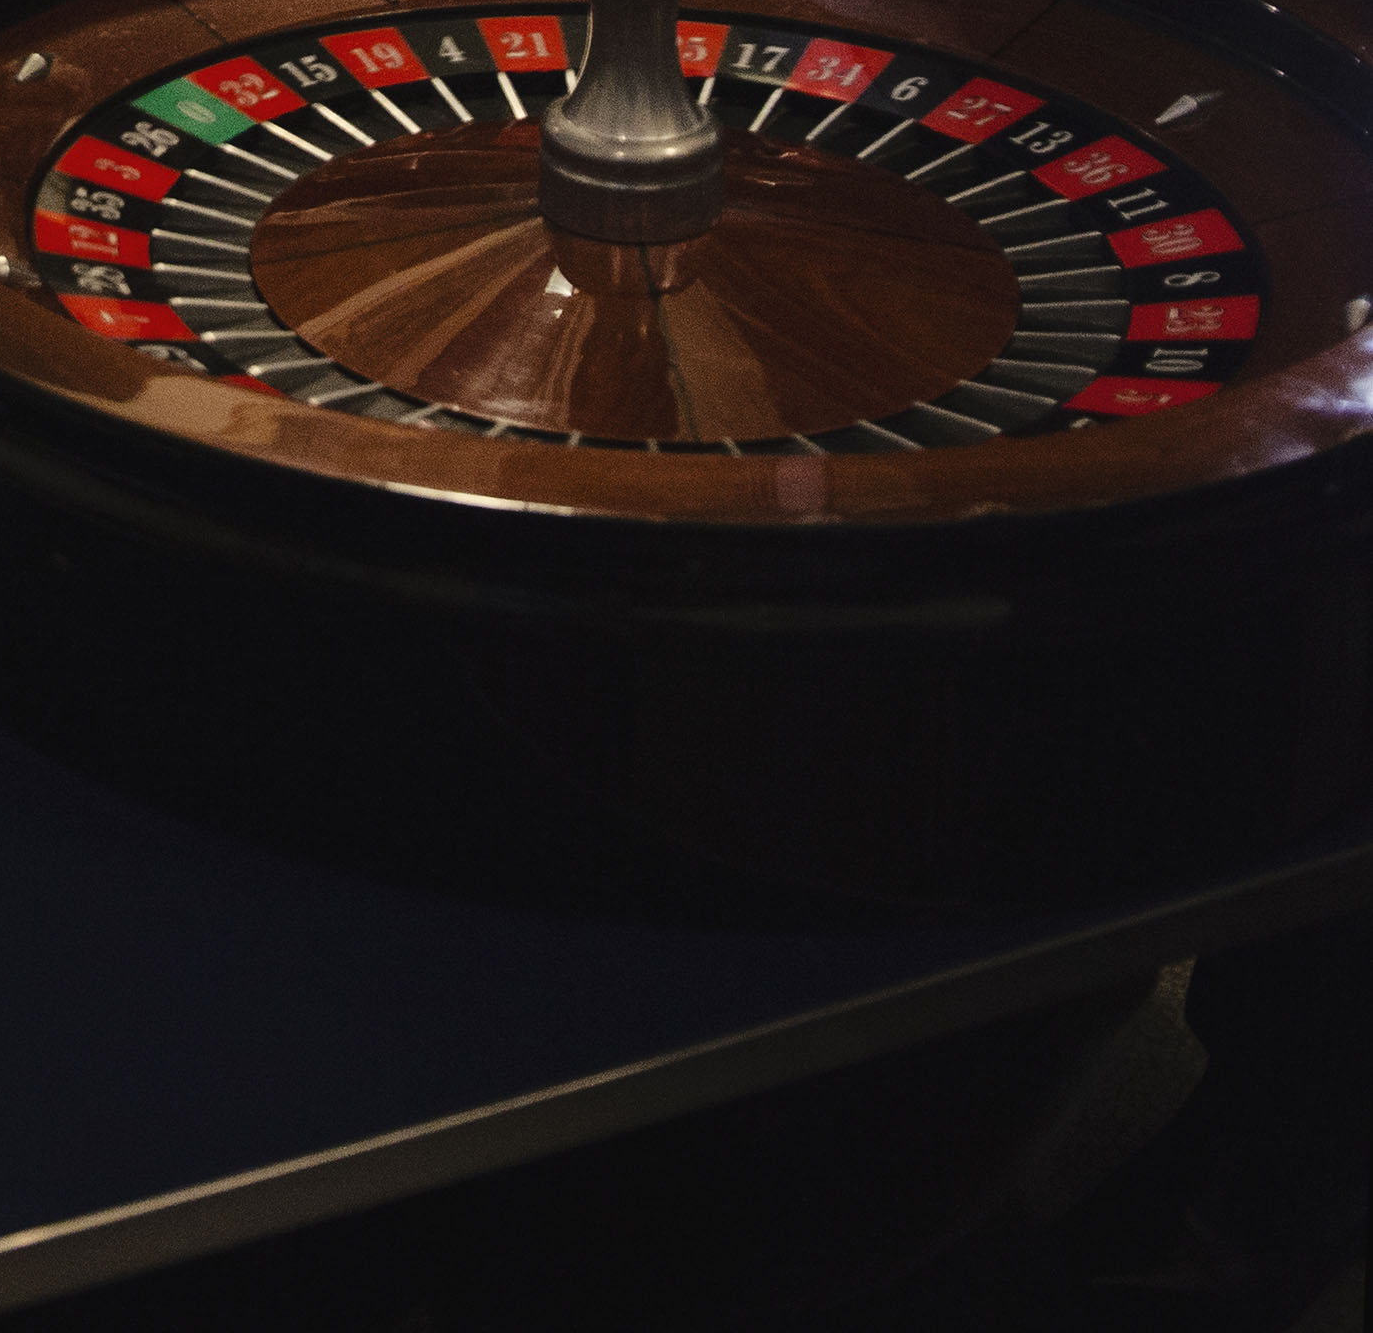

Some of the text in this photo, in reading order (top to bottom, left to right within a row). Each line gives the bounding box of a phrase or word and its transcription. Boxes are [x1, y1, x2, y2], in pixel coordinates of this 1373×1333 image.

[350, 42, 405, 74] 19
[438, 35, 467, 63] 4
[499, 31, 551, 59] 21
[676, 35, 709, 63] 5
[731, 42, 791, 73] 17
[279, 54, 337, 88] 15
[806, 56, 865, 87] 34
[219, 73, 280, 107] 32
[890, 75, 929, 102] 6
[176, 100, 216, 123] 0
[946, 94, 1013, 127] 27
[1010, 120, 1074, 155] 13
[1063, 151, 1128, 185] 36
[1106, 187, 1170, 221] 11
[1141, 223, 1204, 255] 30
[1163, 270, 1222, 288] 8
[1144, 347, 1210, 374] 10
